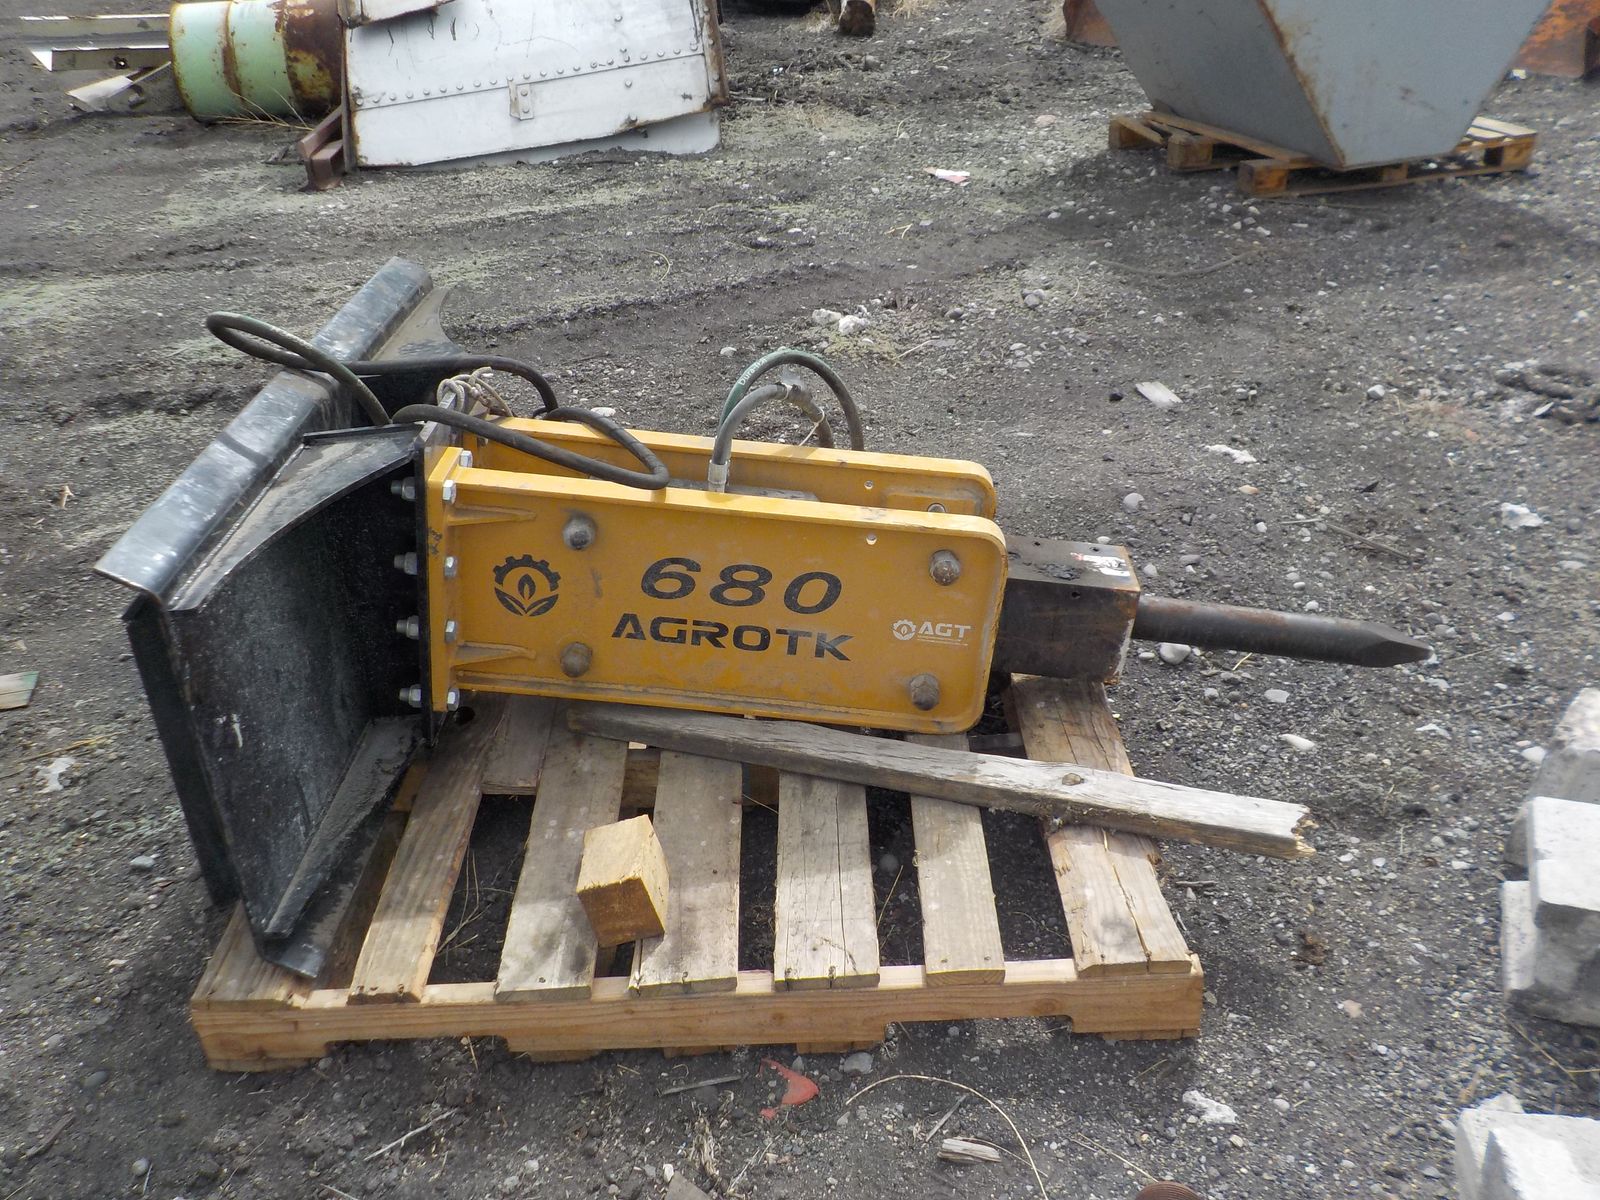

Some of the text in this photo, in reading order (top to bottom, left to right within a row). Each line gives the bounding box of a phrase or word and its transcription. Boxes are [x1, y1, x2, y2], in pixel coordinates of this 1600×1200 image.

[640, 557, 842, 615] 680
[611, 613, 854, 662] AGROTK
[918, 621, 971, 638] AGT
